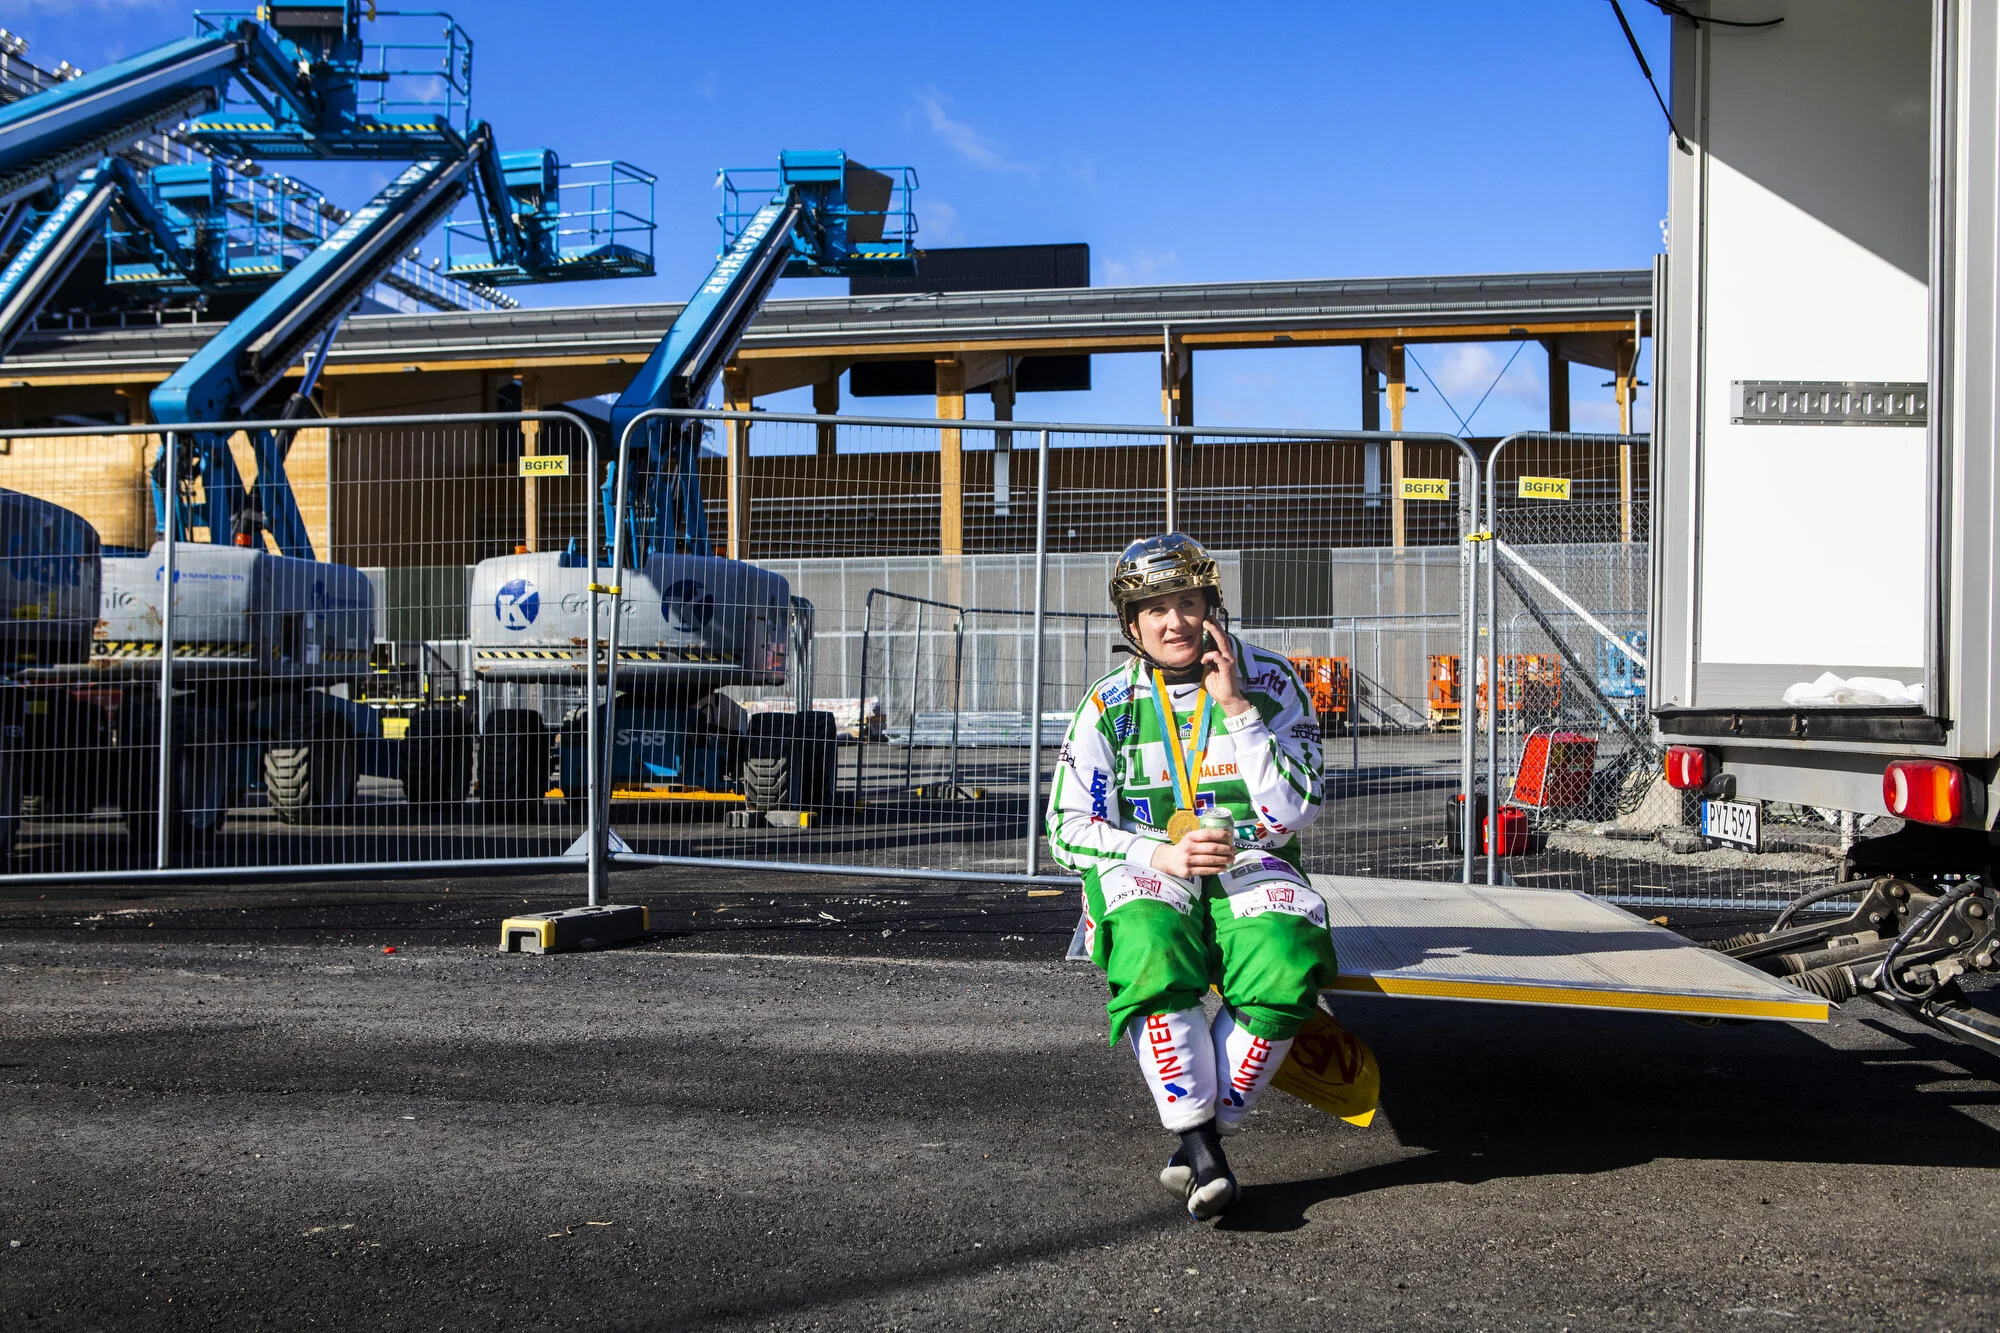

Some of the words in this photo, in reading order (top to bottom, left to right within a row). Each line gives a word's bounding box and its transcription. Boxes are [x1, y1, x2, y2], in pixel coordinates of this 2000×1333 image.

[702, 209, 779, 294] KRANPUNKTEN
[525, 460, 563, 470] BGFIX
[1404, 483, 1444, 494] BGFIX
[1524, 481, 1565, 493] BGFIX
[561, 593, 637, 617] Gne
[1101, 685, 1119, 701] Bad
[616, 730, 666, 746] S-65
[1710, 803, 1729, 835] PYZ
[1732, 806, 1752, 840] 592
[1146, 1013, 1184, 1082] INTER
